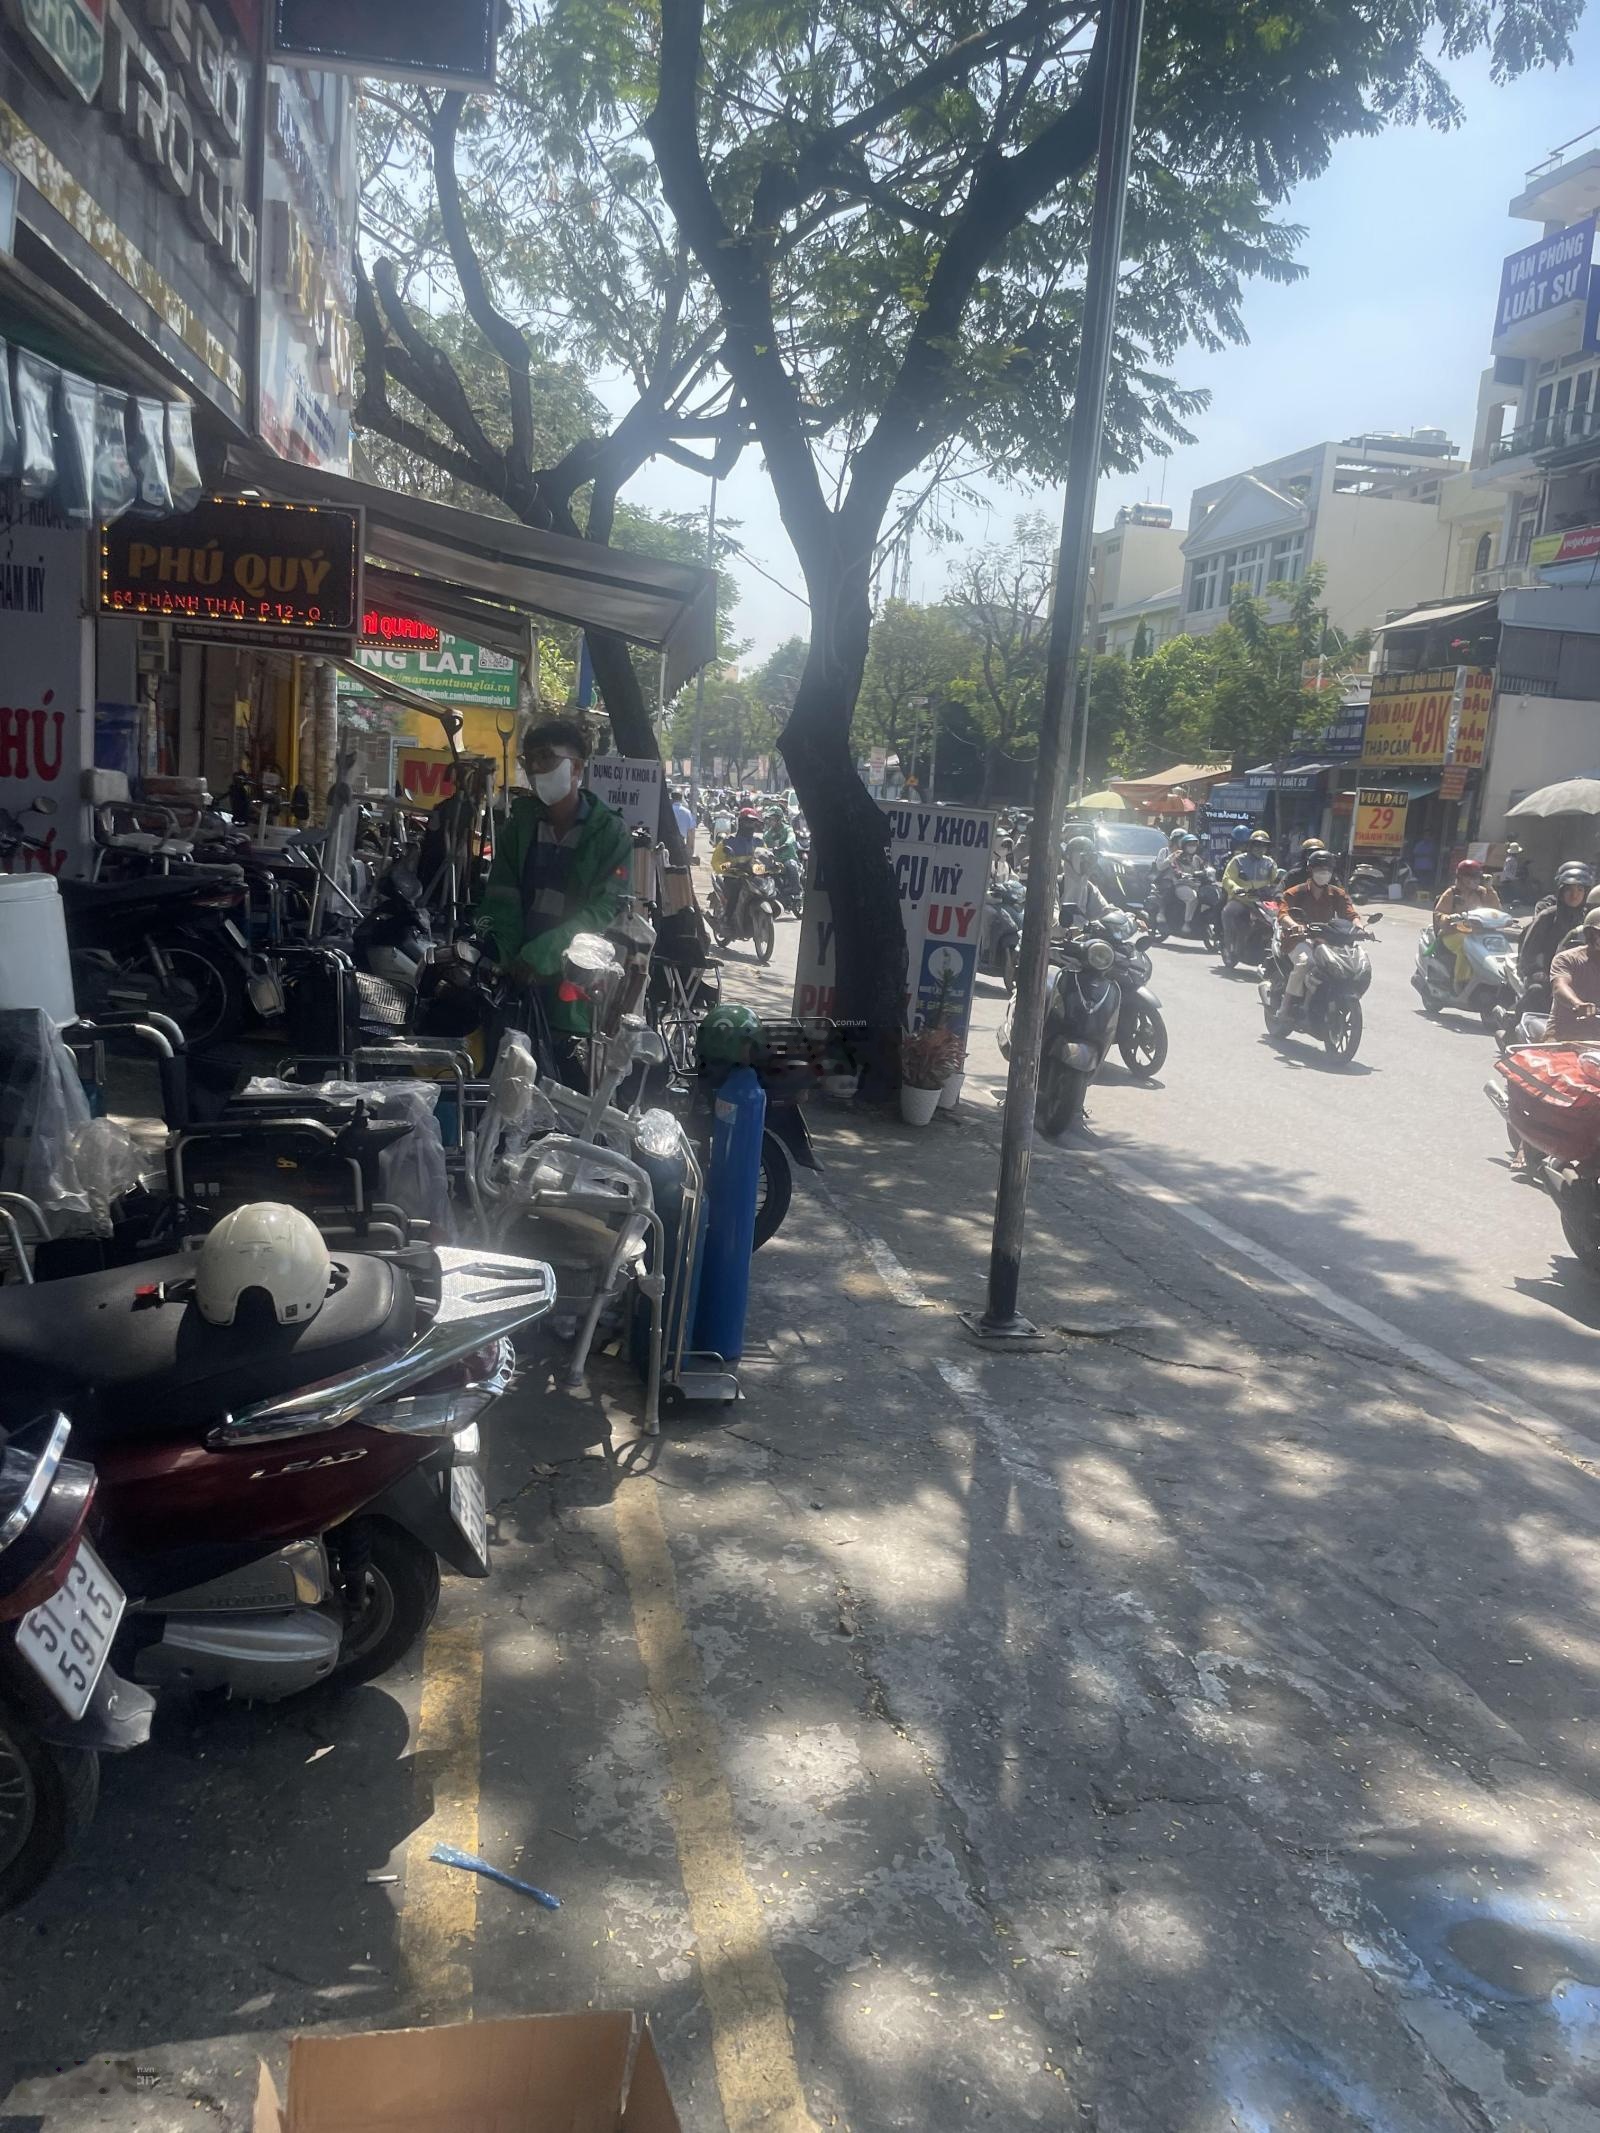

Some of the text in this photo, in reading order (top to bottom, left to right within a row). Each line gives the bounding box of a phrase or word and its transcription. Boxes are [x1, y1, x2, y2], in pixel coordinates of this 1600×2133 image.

[128, 539, 332, 599] PHÚ QUÝ
[138, 589, 199, 611] THÀNH
[204, 596, 245, 615] THÁI
[260, 601, 294, 619] P.12
[419, 651, 474, 676] LAI
[1411, 694, 1453, 755] 49K
[625, 766, 632, 777] Y
[1360, 791, 1381, 804] VUA
[917, 813, 931, 842] Y
[933, 815, 989, 849] KHOA
[1368, 807, 1394, 830] 29
[58, 1580, 113, 1693] 5915
